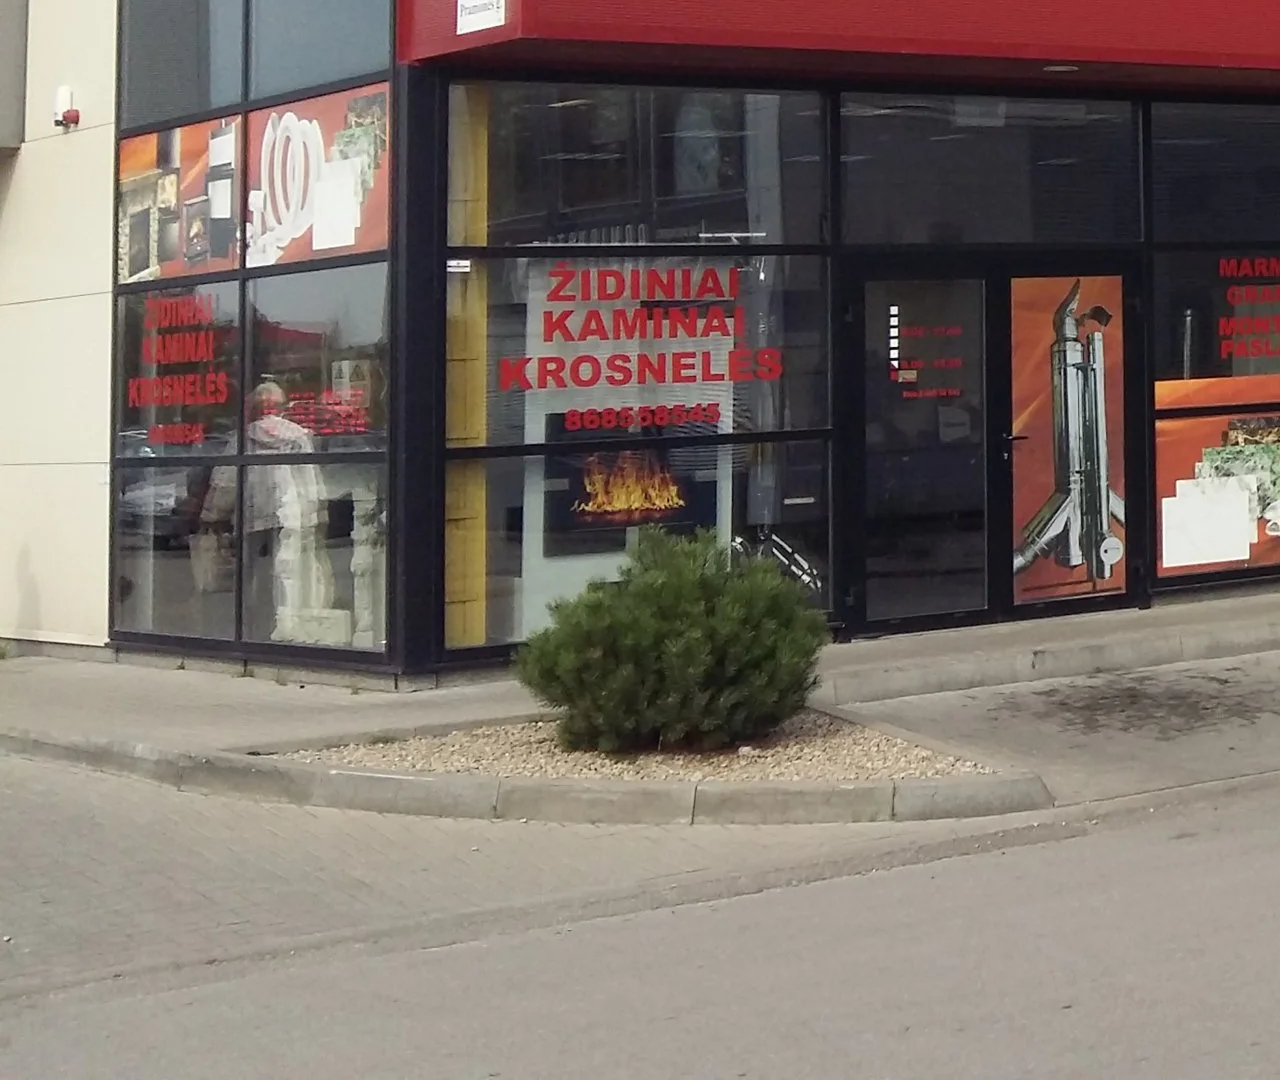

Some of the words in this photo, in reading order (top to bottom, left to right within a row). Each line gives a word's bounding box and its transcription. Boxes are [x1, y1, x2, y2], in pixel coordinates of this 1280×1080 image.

[546, 260, 741, 302] ŽIDINIAI
[543, 305, 746, 343] KAMINAI
[498, 342, 784, 392] KROSNELĖS
